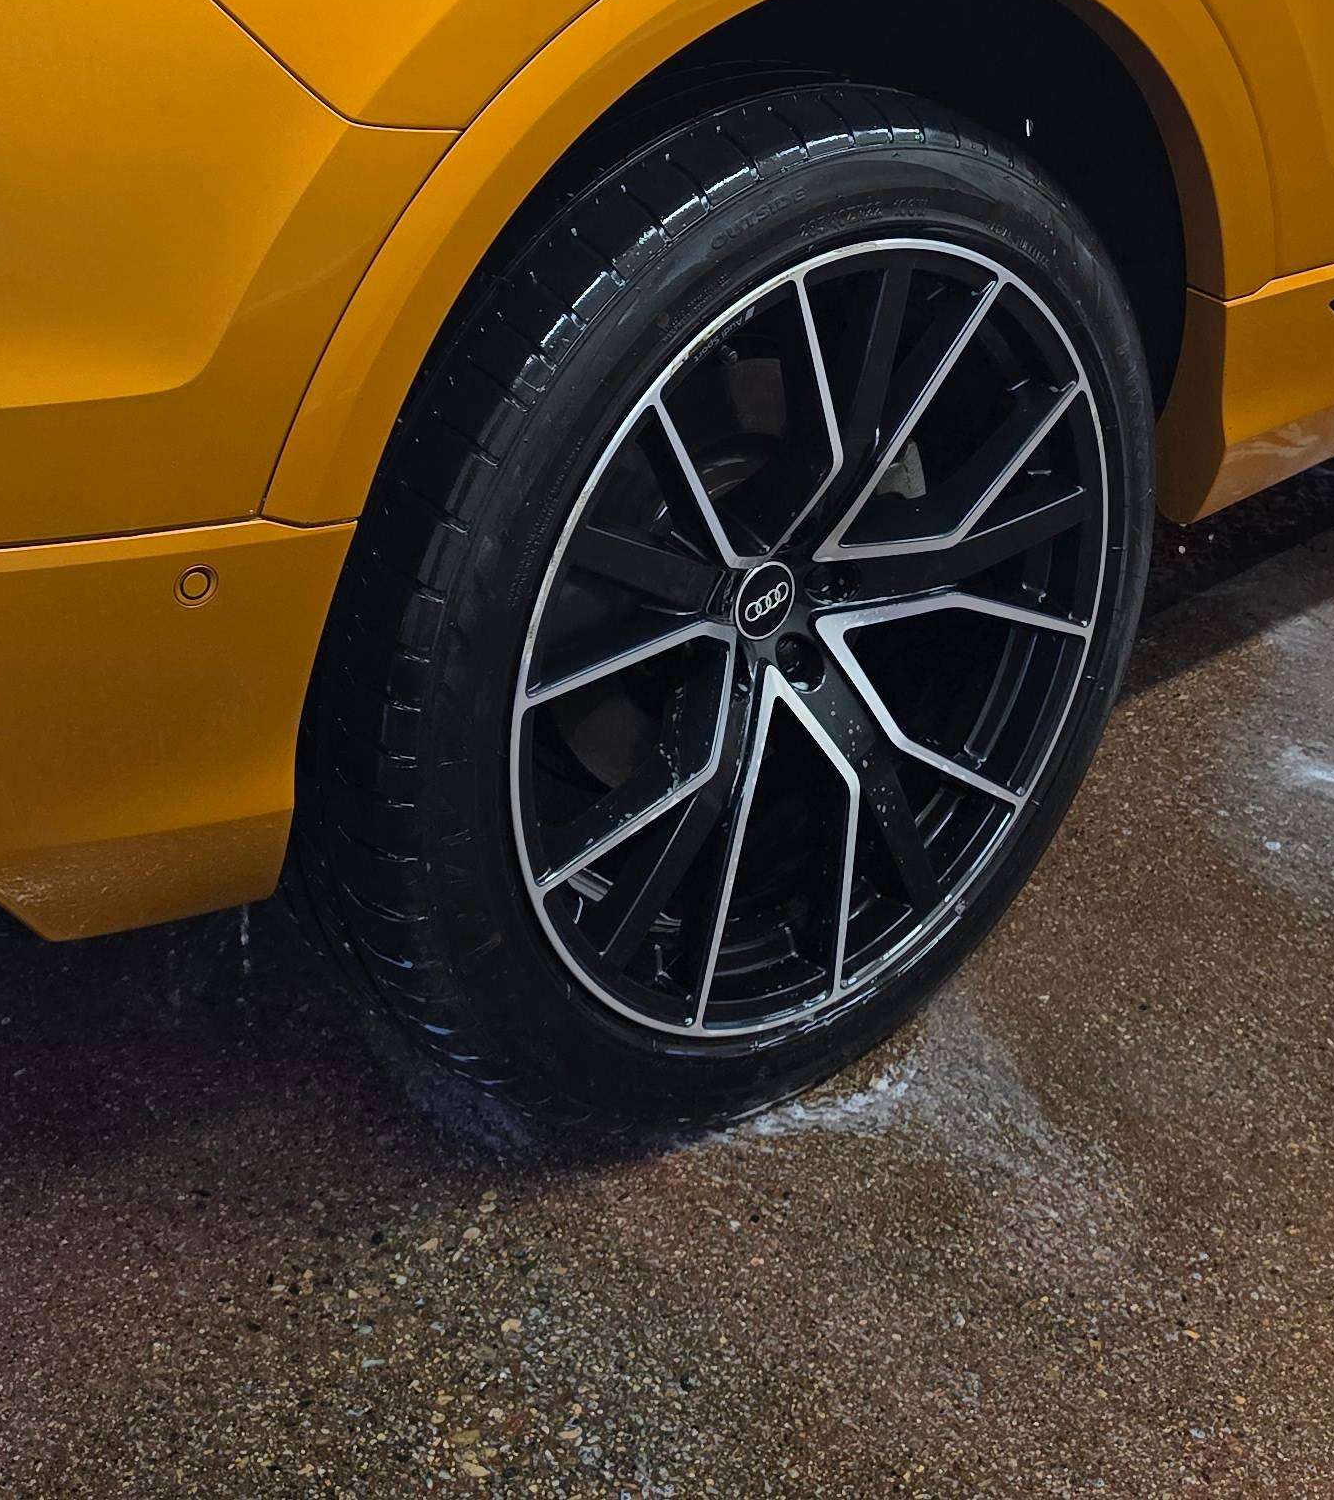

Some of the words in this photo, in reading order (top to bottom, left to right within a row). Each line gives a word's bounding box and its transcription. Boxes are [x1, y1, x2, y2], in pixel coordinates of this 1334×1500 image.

[709, 185, 807, 251] OUTSIDE
[721, 316, 743, 339] Audi
[693, 335, 721, 364] Sport
